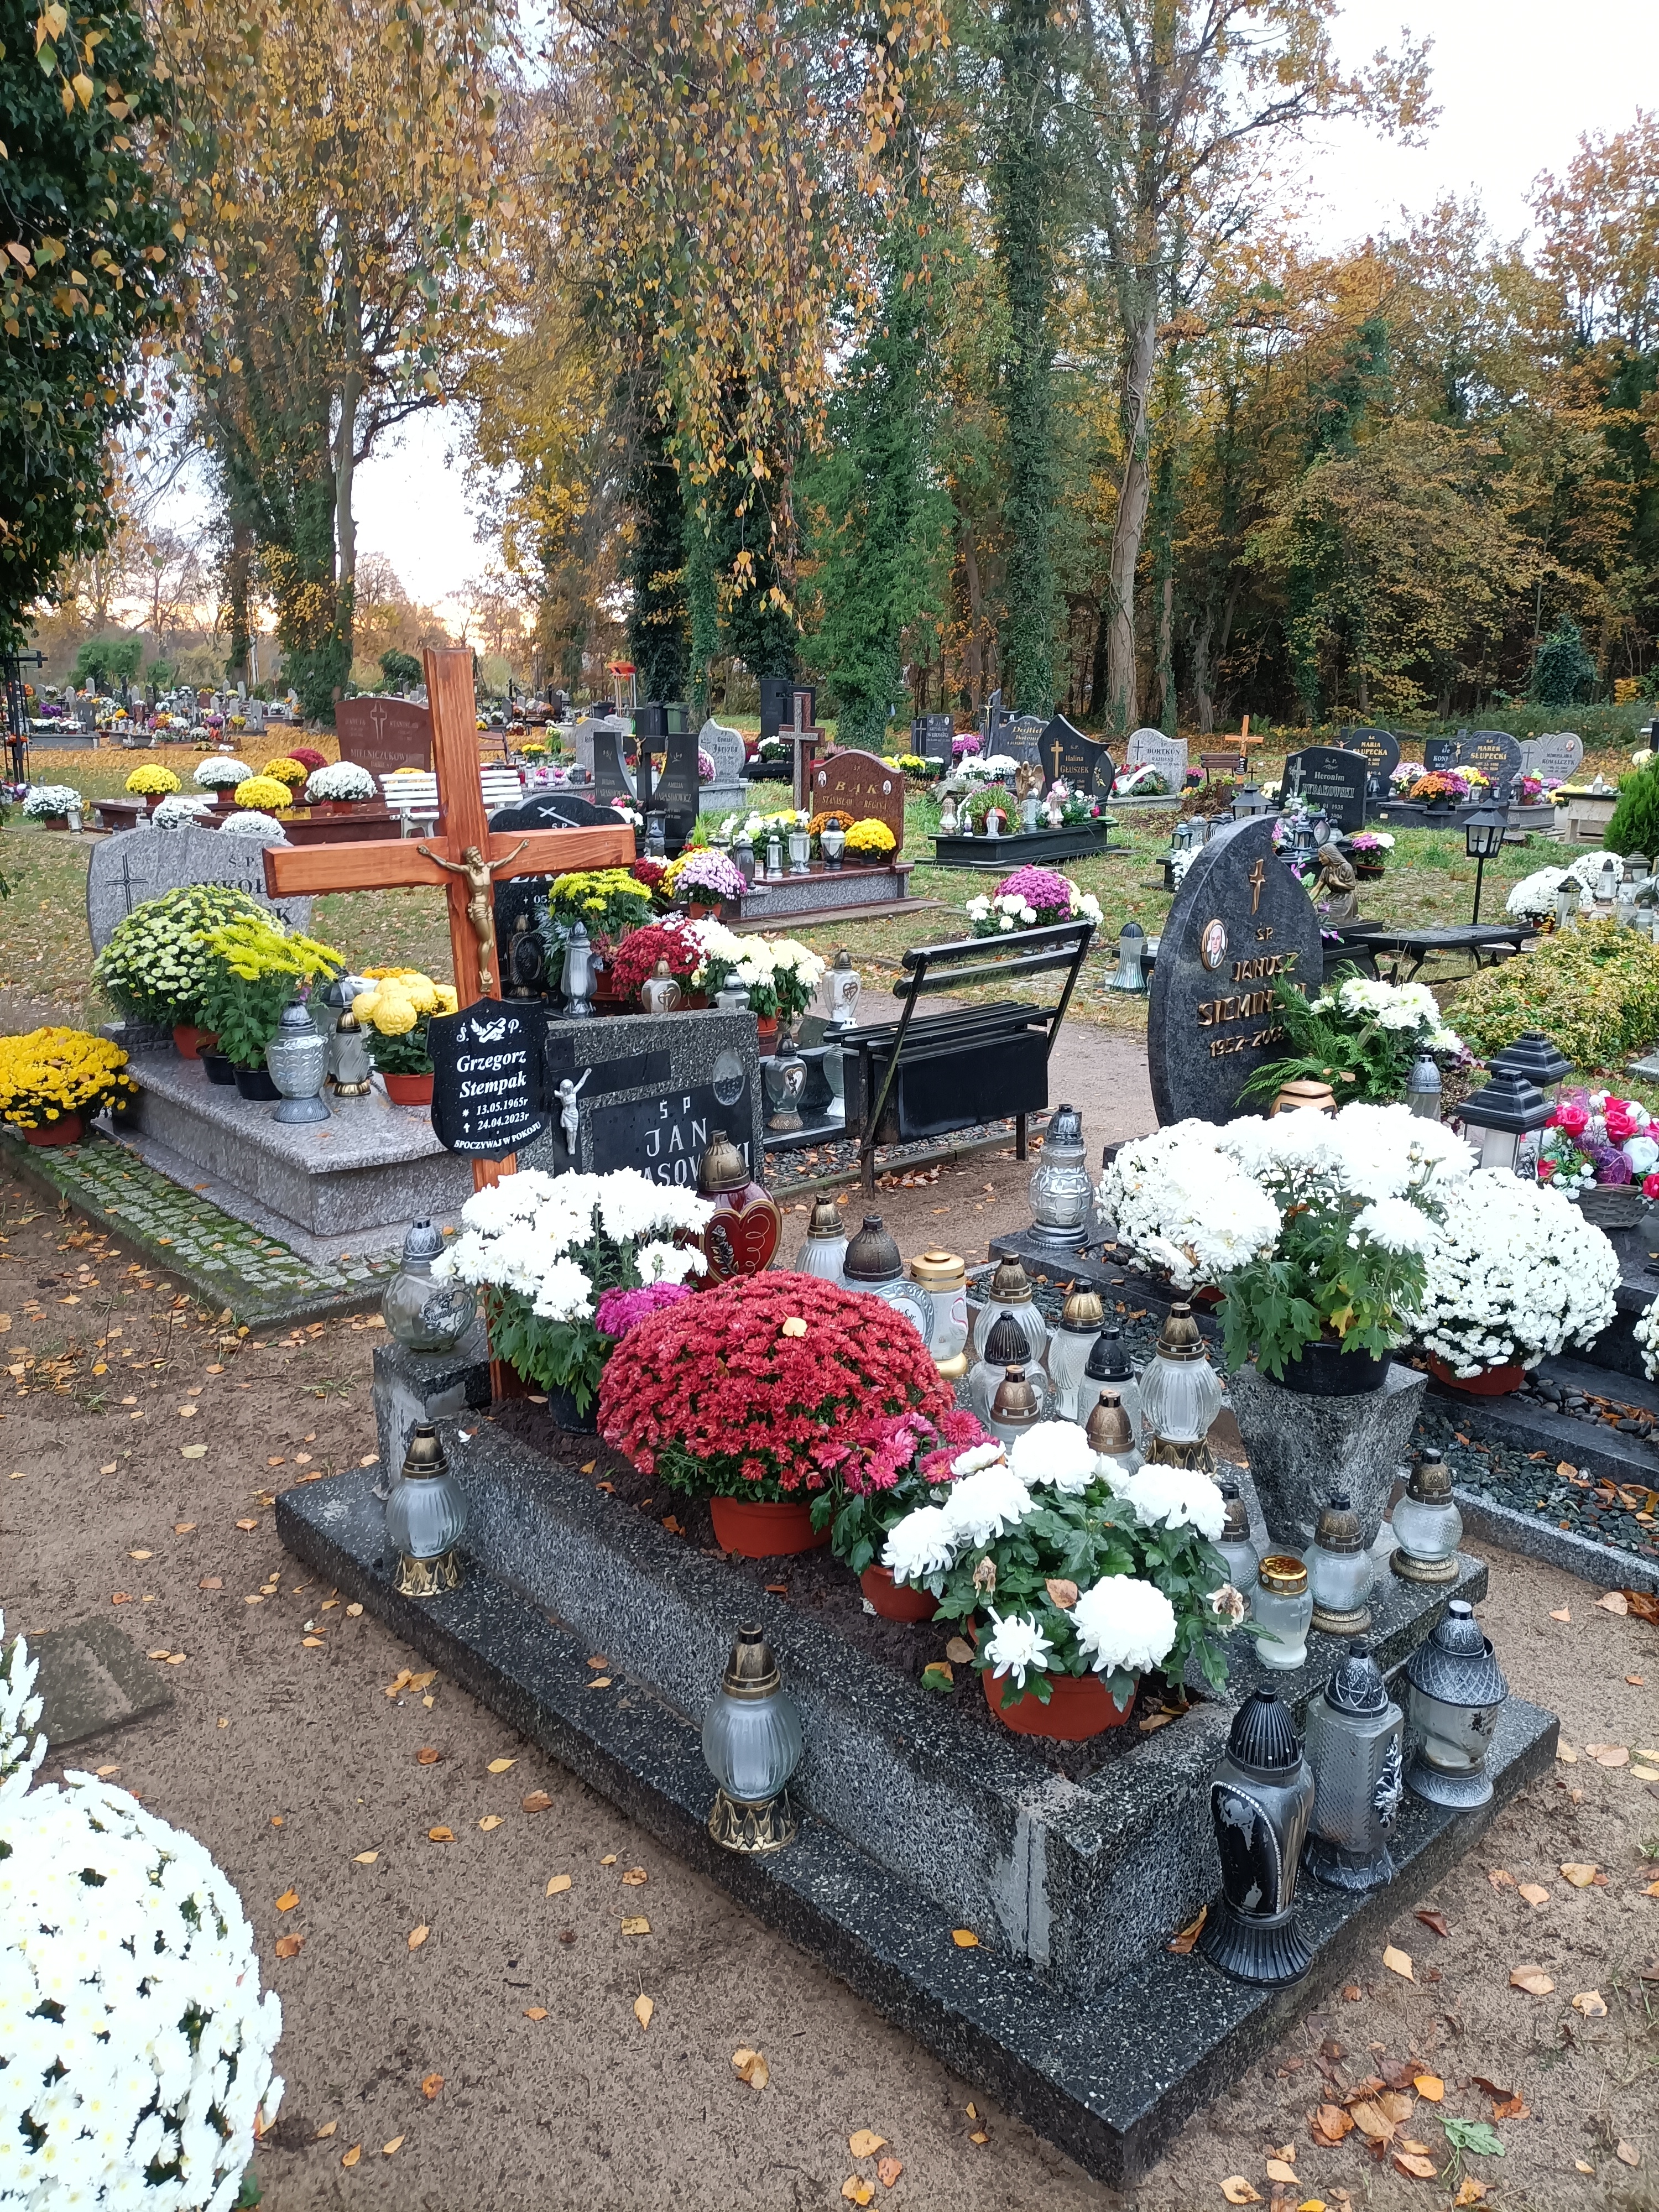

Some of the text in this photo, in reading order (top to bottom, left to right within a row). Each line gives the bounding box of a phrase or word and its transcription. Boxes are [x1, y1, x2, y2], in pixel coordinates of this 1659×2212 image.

[1060, 765, 1089, 774] GŁUSZEK
[1302, 783, 1355, 799] RYBAKOWSKI
[456, 1050, 526, 1073] Grzegorz
[459, 1071, 527, 1099] Stempak
[453, 1121, 541, 1150] SPOCZYWAJ W POKOJU
[644, 1118, 707, 1157] JAN
